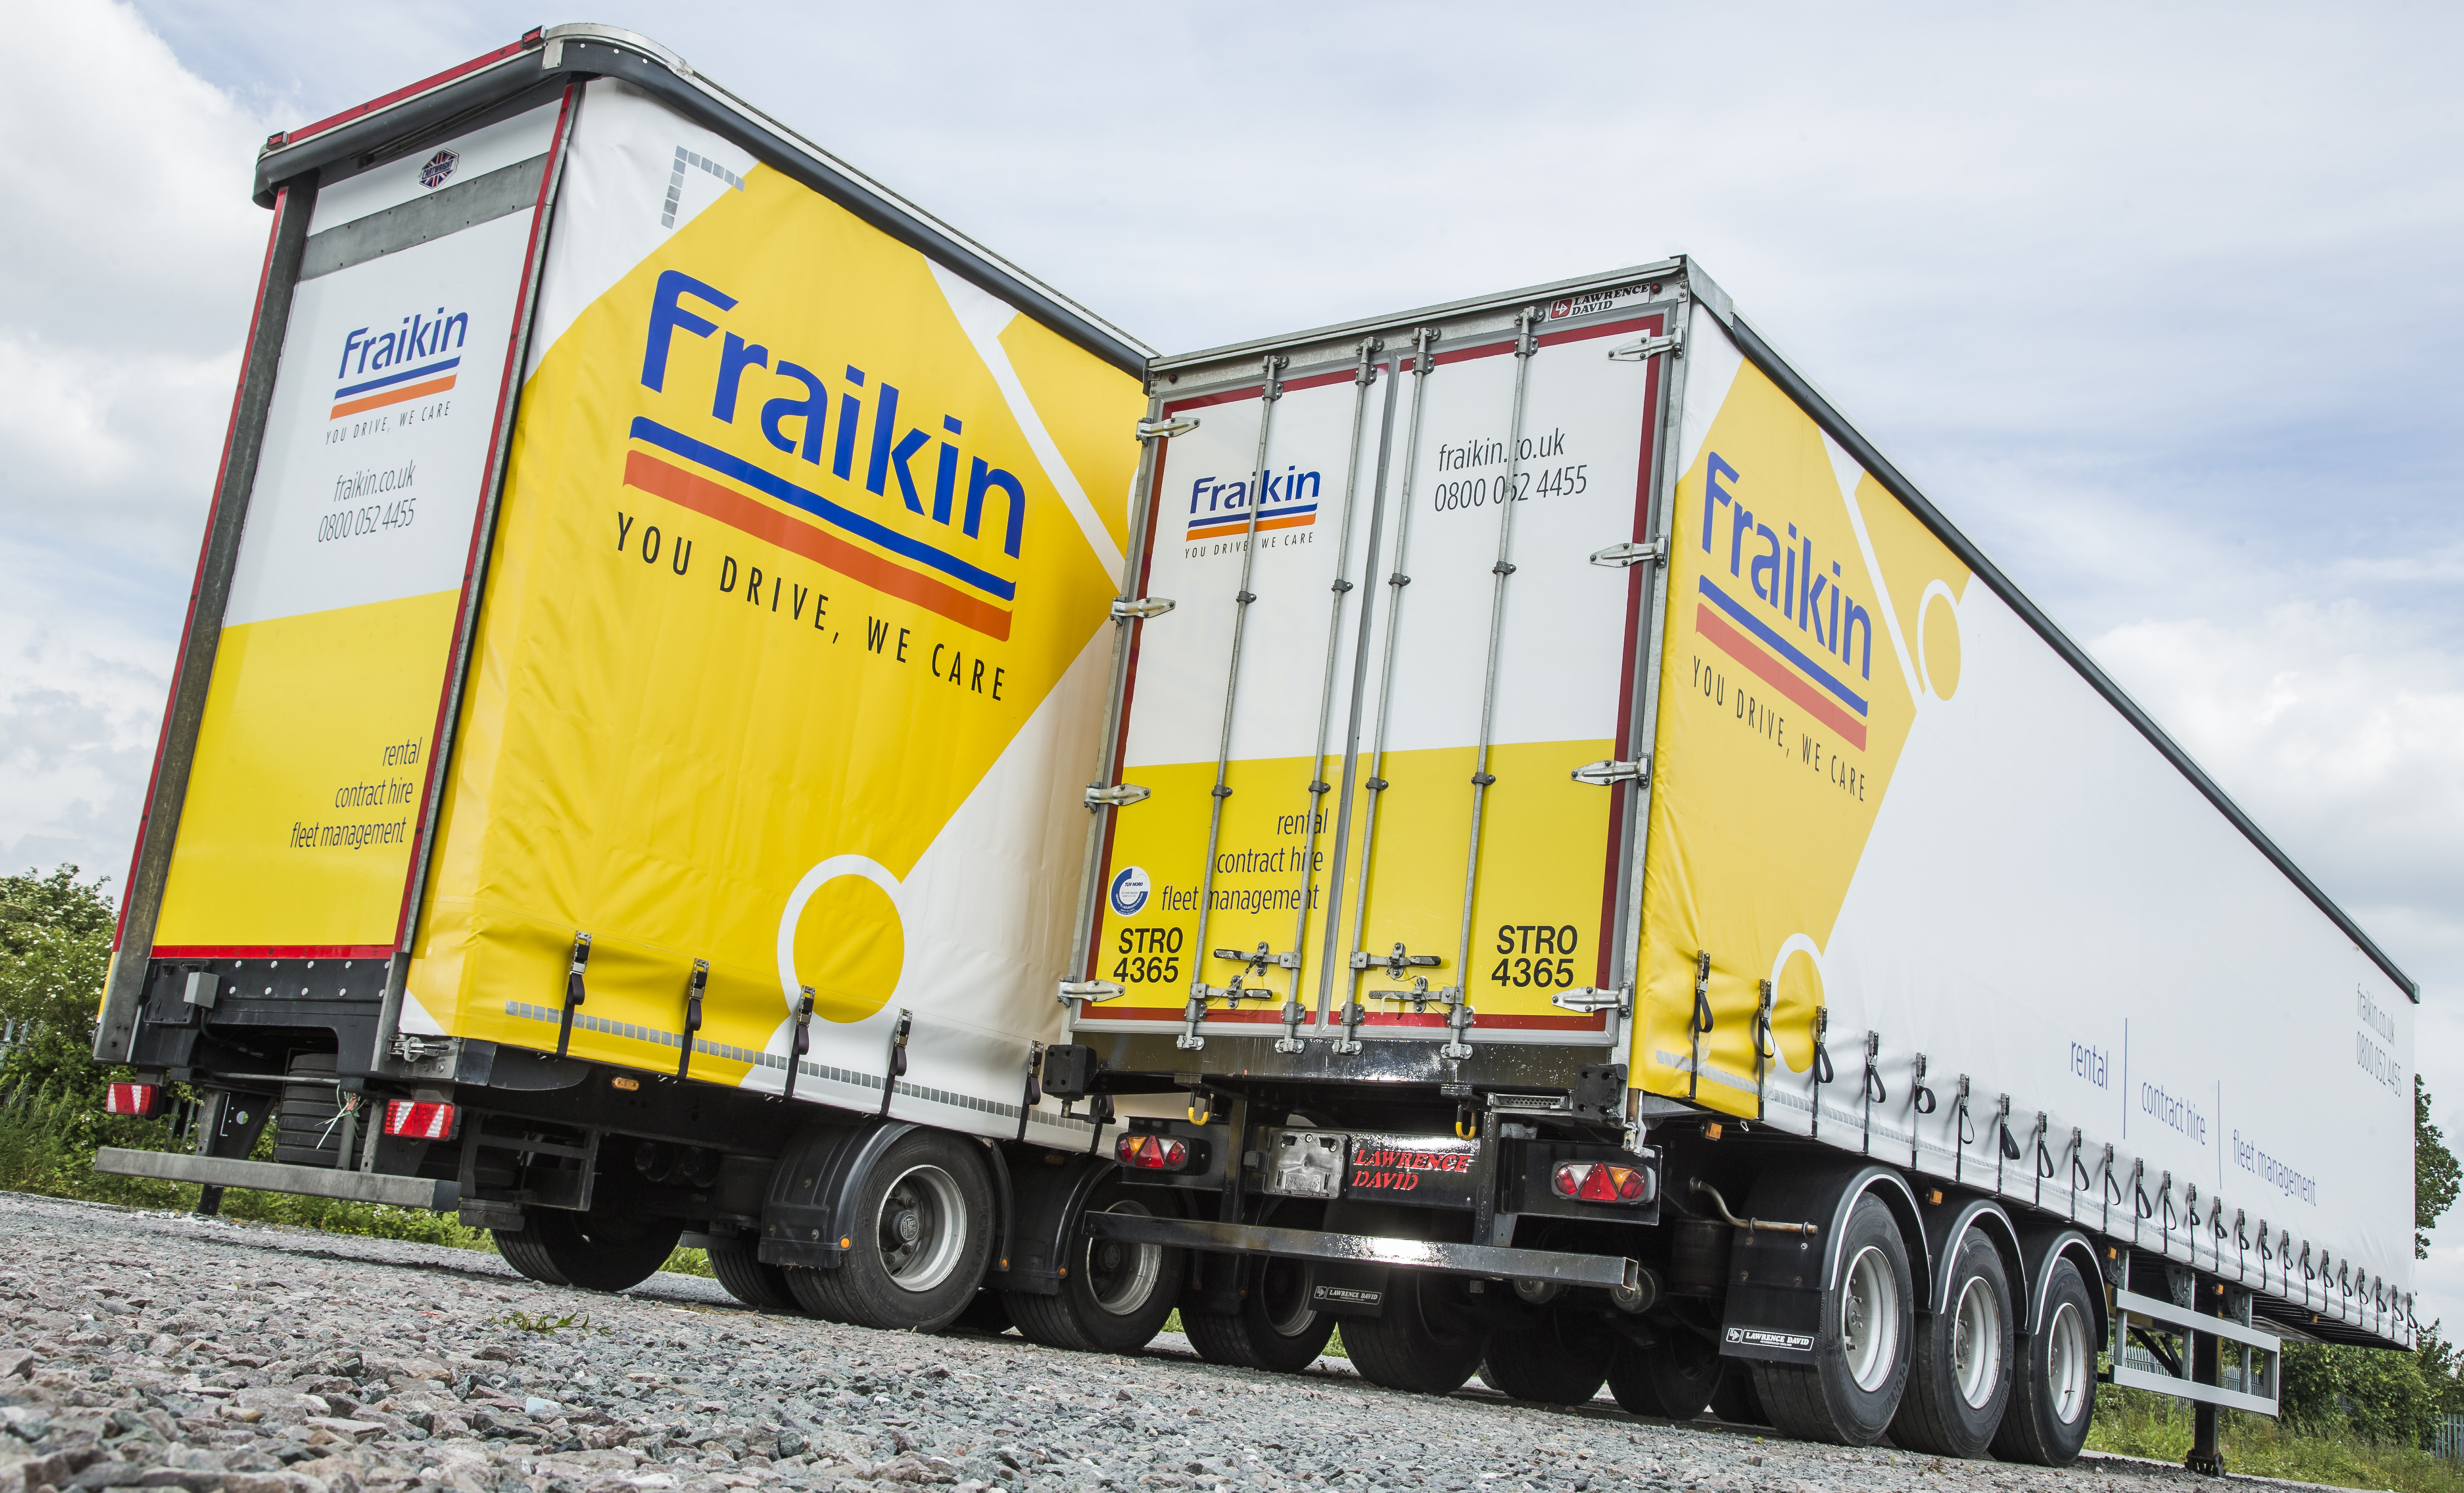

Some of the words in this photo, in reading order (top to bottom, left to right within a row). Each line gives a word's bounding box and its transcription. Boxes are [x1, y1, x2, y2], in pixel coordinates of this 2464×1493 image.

[1571, 300, 1613, 316] DAVID
[1574, 284, 1650, 306] LAWRENCE
[338, 307, 469, 379] Fraikin
[326, 427, 346, 445] YOU
[353, 417, 390, 438] DRIVE,
[400, 410, 415, 427] WE
[422, 401, 449, 421] CARE
[641, 270, 1026, 560] Fraikin
[1440, 427, 1566, 472] fraikin.o.uk
[334, 460, 417, 502] fraikin.co.uk
[1190, 465, 1321, 514] Fraikin
[1435, 478, 1486, 512] 0800
[1536, 464, 1587, 498] 4455
[319, 510, 353, 543] 0800
[355, 505, 381, 535] 052
[382, 498, 417, 530] 4455
[1185, 546, 1206, 559] YOU
[1262, 537, 1276, 548] WE
[1285, 532, 1313, 546] CARE
[1702, 451, 1871, 681] Fraikin
[618, 511, 692, 576] YOU
[719, 555, 839, 644] DRIVE,
[868, 616, 911, 664] WE
[931, 643, 1005, 701] CARE
[1693, 655, 1725, 707] YOU
[1737, 687, 1789, 758] DRIVE,
[1802, 732, 1821, 772] WE
[1831, 754, 1865, 802] CARE
[382, 736, 422, 766] rental
[335, 779, 386, 808] contract
[387, 777, 413, 804] hire
[290, 821, 319, 848] fleet
[320, 817, 406, 850] management
[1277, 808, 1328, 835] rental
[1217, 847, 1286, 873] contract
[1290, 846, 1323, 872] hie
[1162, 886, 1199, 911] fleet
[1118, 927, 1183, 954] STRO
[1497, 925, 1578, 955] STRO
[1113, 956, 1179, 983] 4365
[1491, 958, 1574, 988] 4365
[2357, 983, 2395, 1047] fraikin.co.uk
[2071, 1041, 2108, 1090] rental
[2357, 1031, 2373, 1075] 0800
[2375, 1046, 2386, 1086] 052
[2387, 1057, 2401, 1098] 4455
[2142, 1081, 2184, 1133] contract
[2187, 1099, 2206, 1146] hire
[1353, 1149, 1471, 1173] LAWRENCE
[2233, 1128, 2256, 1174] fleet
[2258, 1150, 2317, 1207] management
[1351, 1170, 1419, 1191] DAVID
[1329, 1290, 1359, 1298] LAWRENCE
[1746, 1332, 1785, 1343] LAWRENCE
[1786, 1337, 1809, 1346] DAVID
